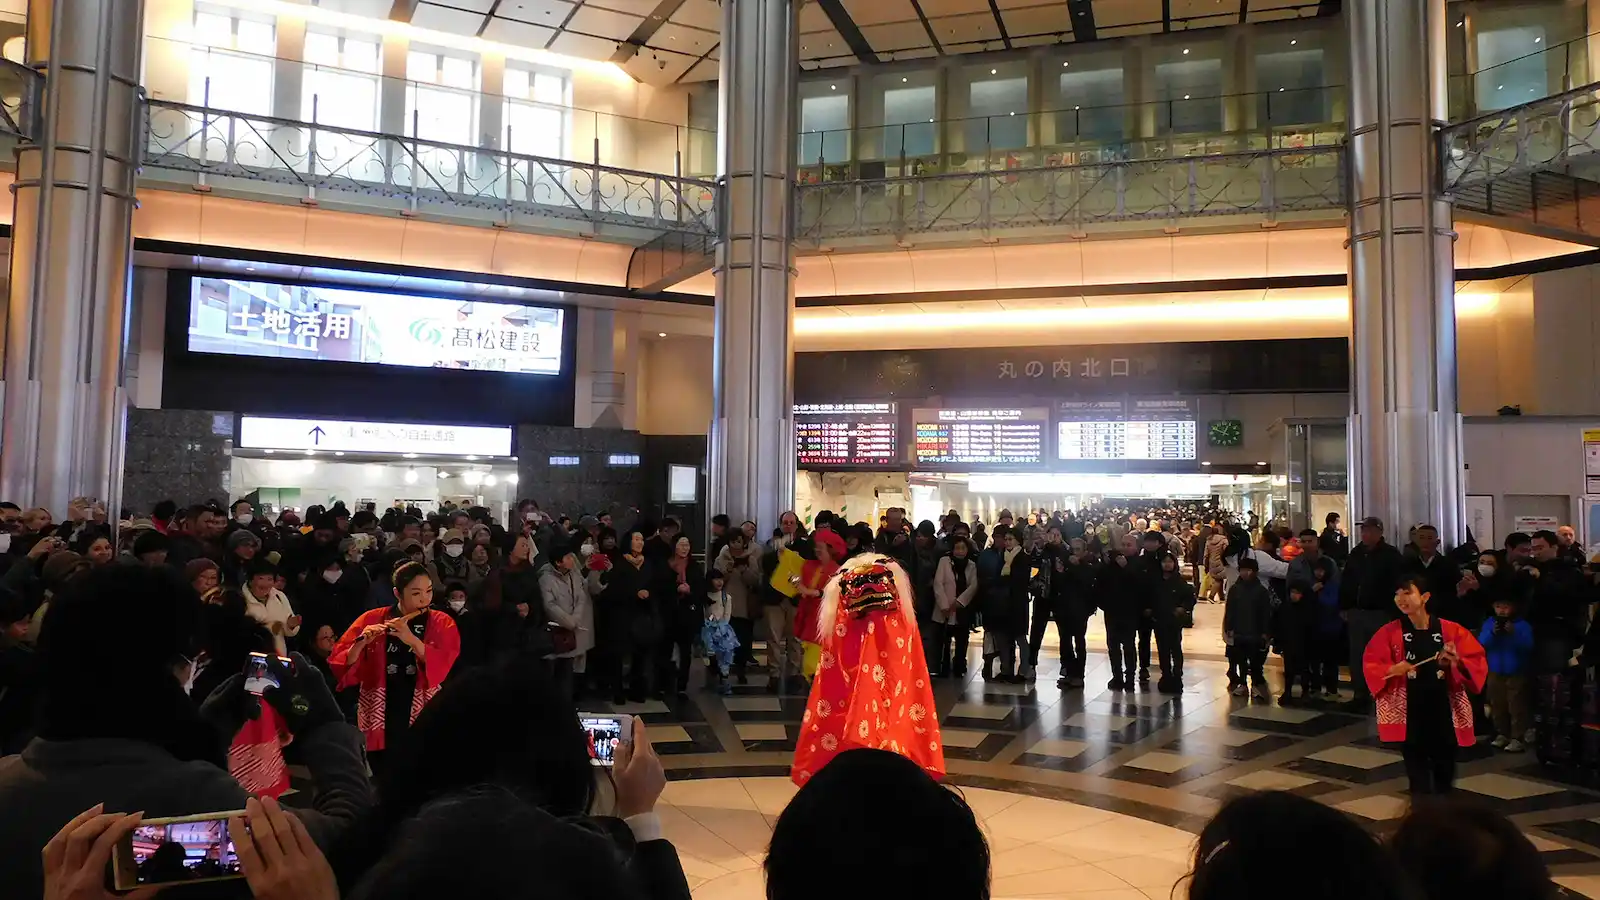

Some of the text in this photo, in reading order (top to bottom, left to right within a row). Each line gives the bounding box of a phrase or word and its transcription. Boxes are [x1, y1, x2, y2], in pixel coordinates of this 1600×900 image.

[229, 305, 350, 340] 土地活用
[997, 357, 1130, 378] 丸の内北口
